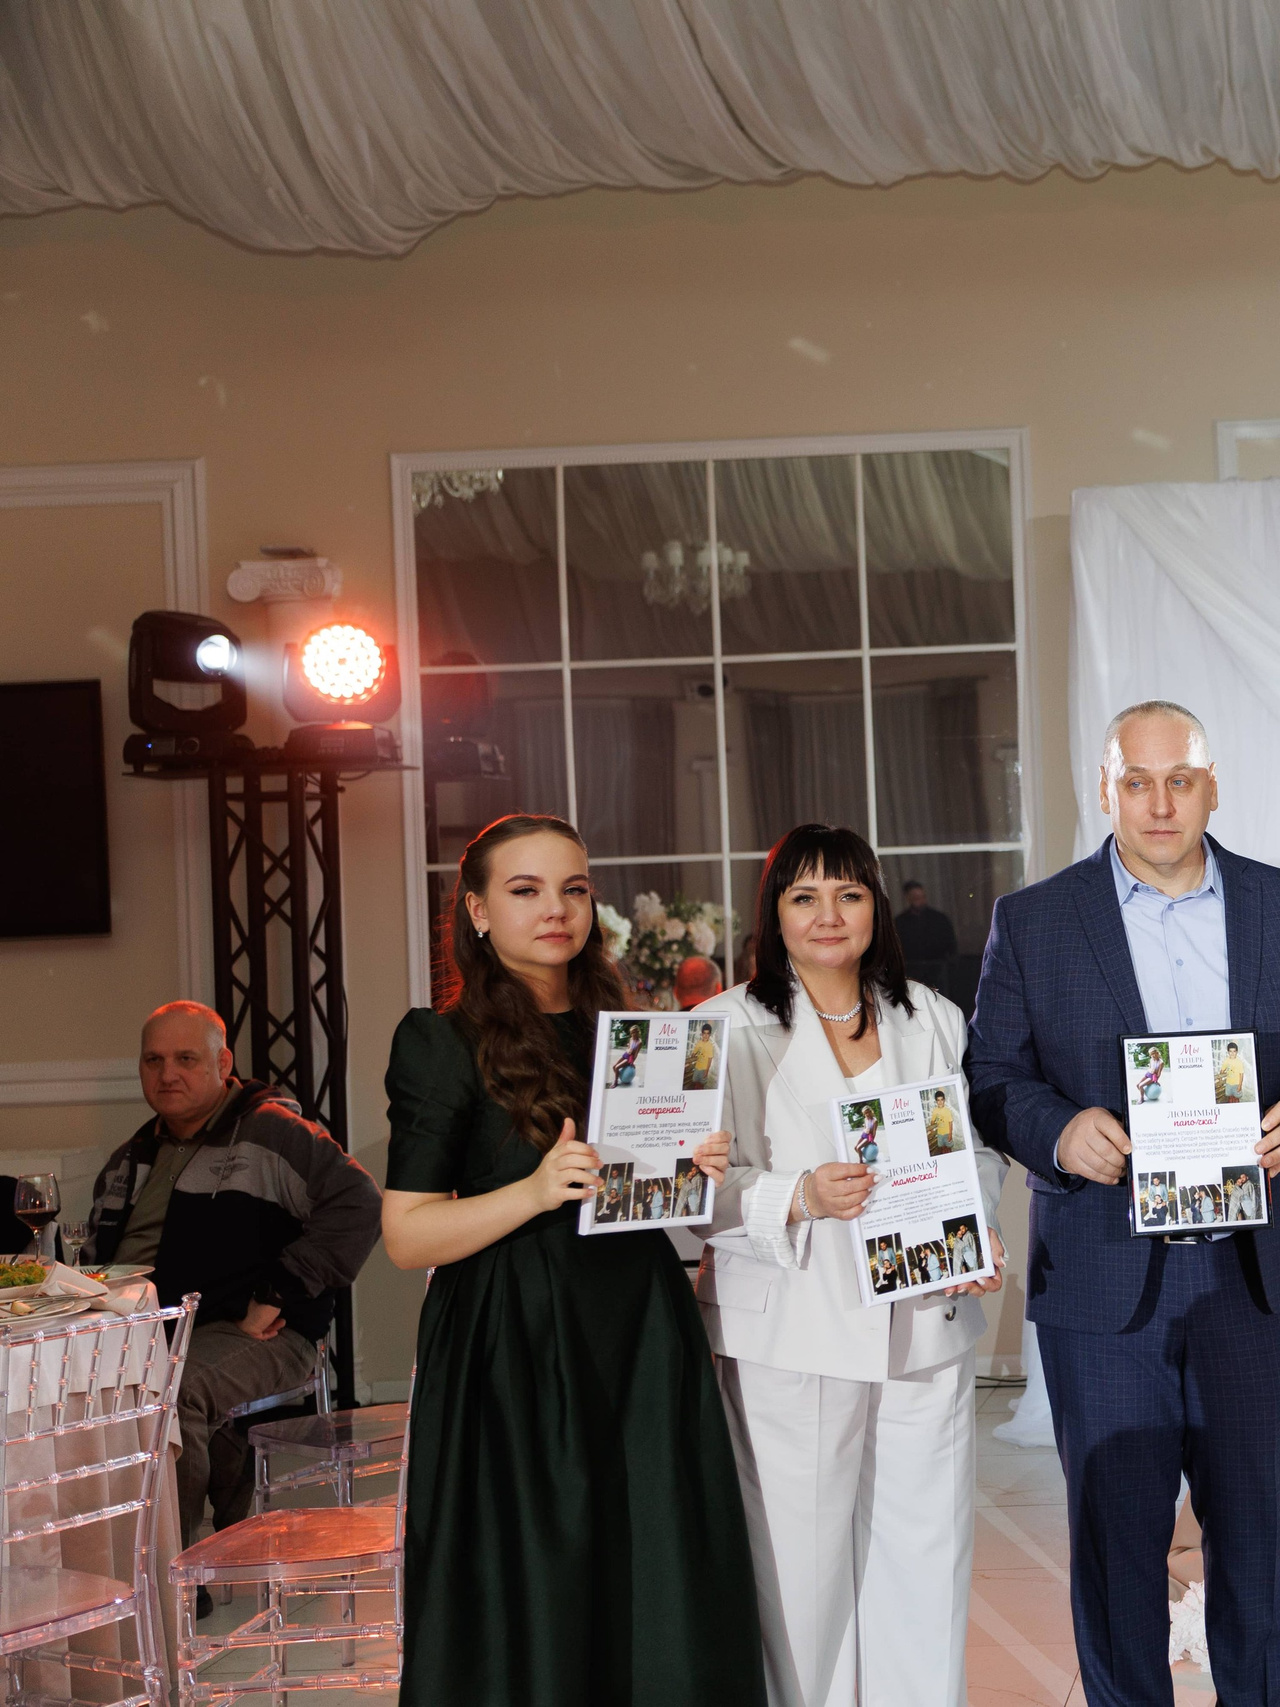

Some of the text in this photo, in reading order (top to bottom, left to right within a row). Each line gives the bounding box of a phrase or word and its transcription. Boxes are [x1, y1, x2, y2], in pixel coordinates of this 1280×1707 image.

[659, 1023, 677, 1036] Мы
[1180, 1044, 1200, 1056] Мы
[636, 1094, 685, 1105] ЛЮБИМЫЙ
[891, 1098, 910, 1111] Мы
[638, 1102, 687, 1120] сестренка!
[889, 1110, 915, 1120] ТЕПЕРЬ
[1168, 1107, 1220, 1118] ЛЮБИМЫЙ
[1173, 1114, 1218, 1127] папочка!
[885, 1159, 938, 1178] ЛЮБИМАЯ
[891, 1167, 938, 1187] мамочка!
